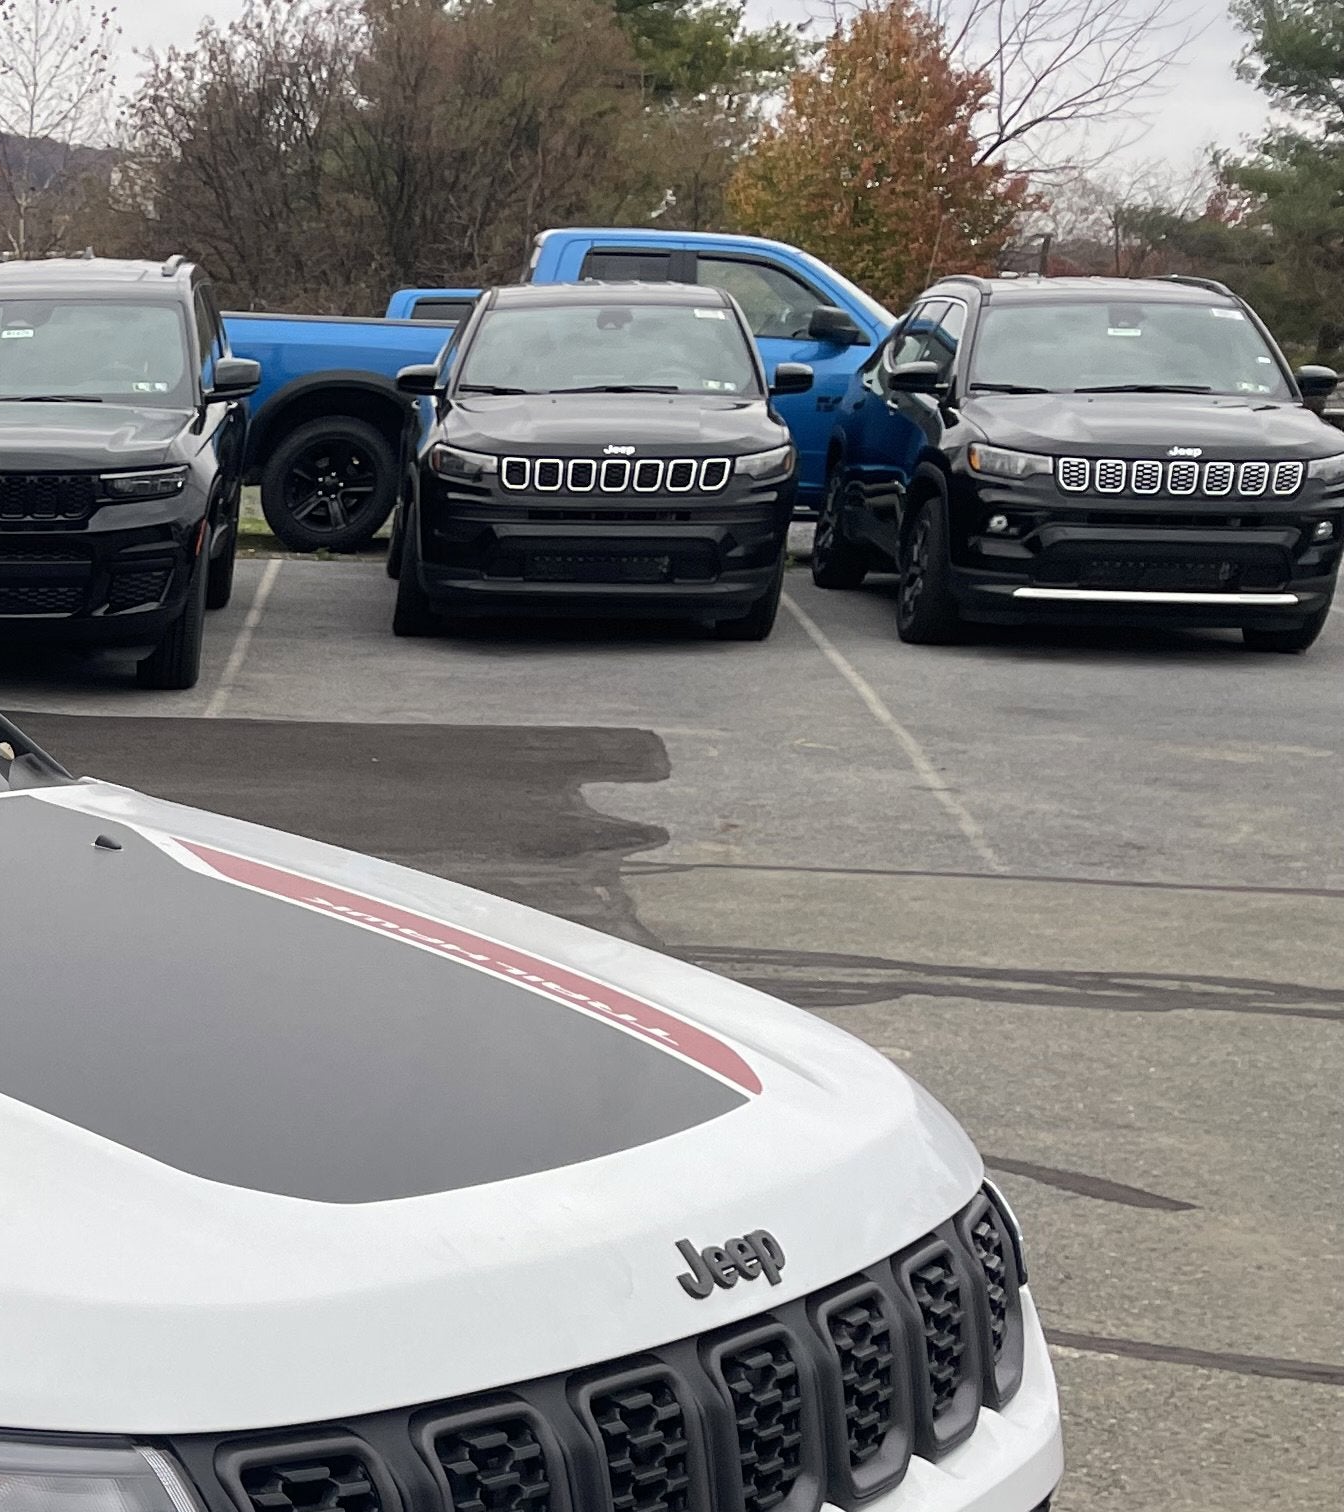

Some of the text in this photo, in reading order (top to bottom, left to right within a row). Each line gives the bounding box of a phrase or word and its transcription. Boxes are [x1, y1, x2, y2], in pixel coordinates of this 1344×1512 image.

[603, 444, 636, 456] Jeep
[1167, 445, 1203, 458] Jeep
[673, 1228, 787, 1300] Jeep
